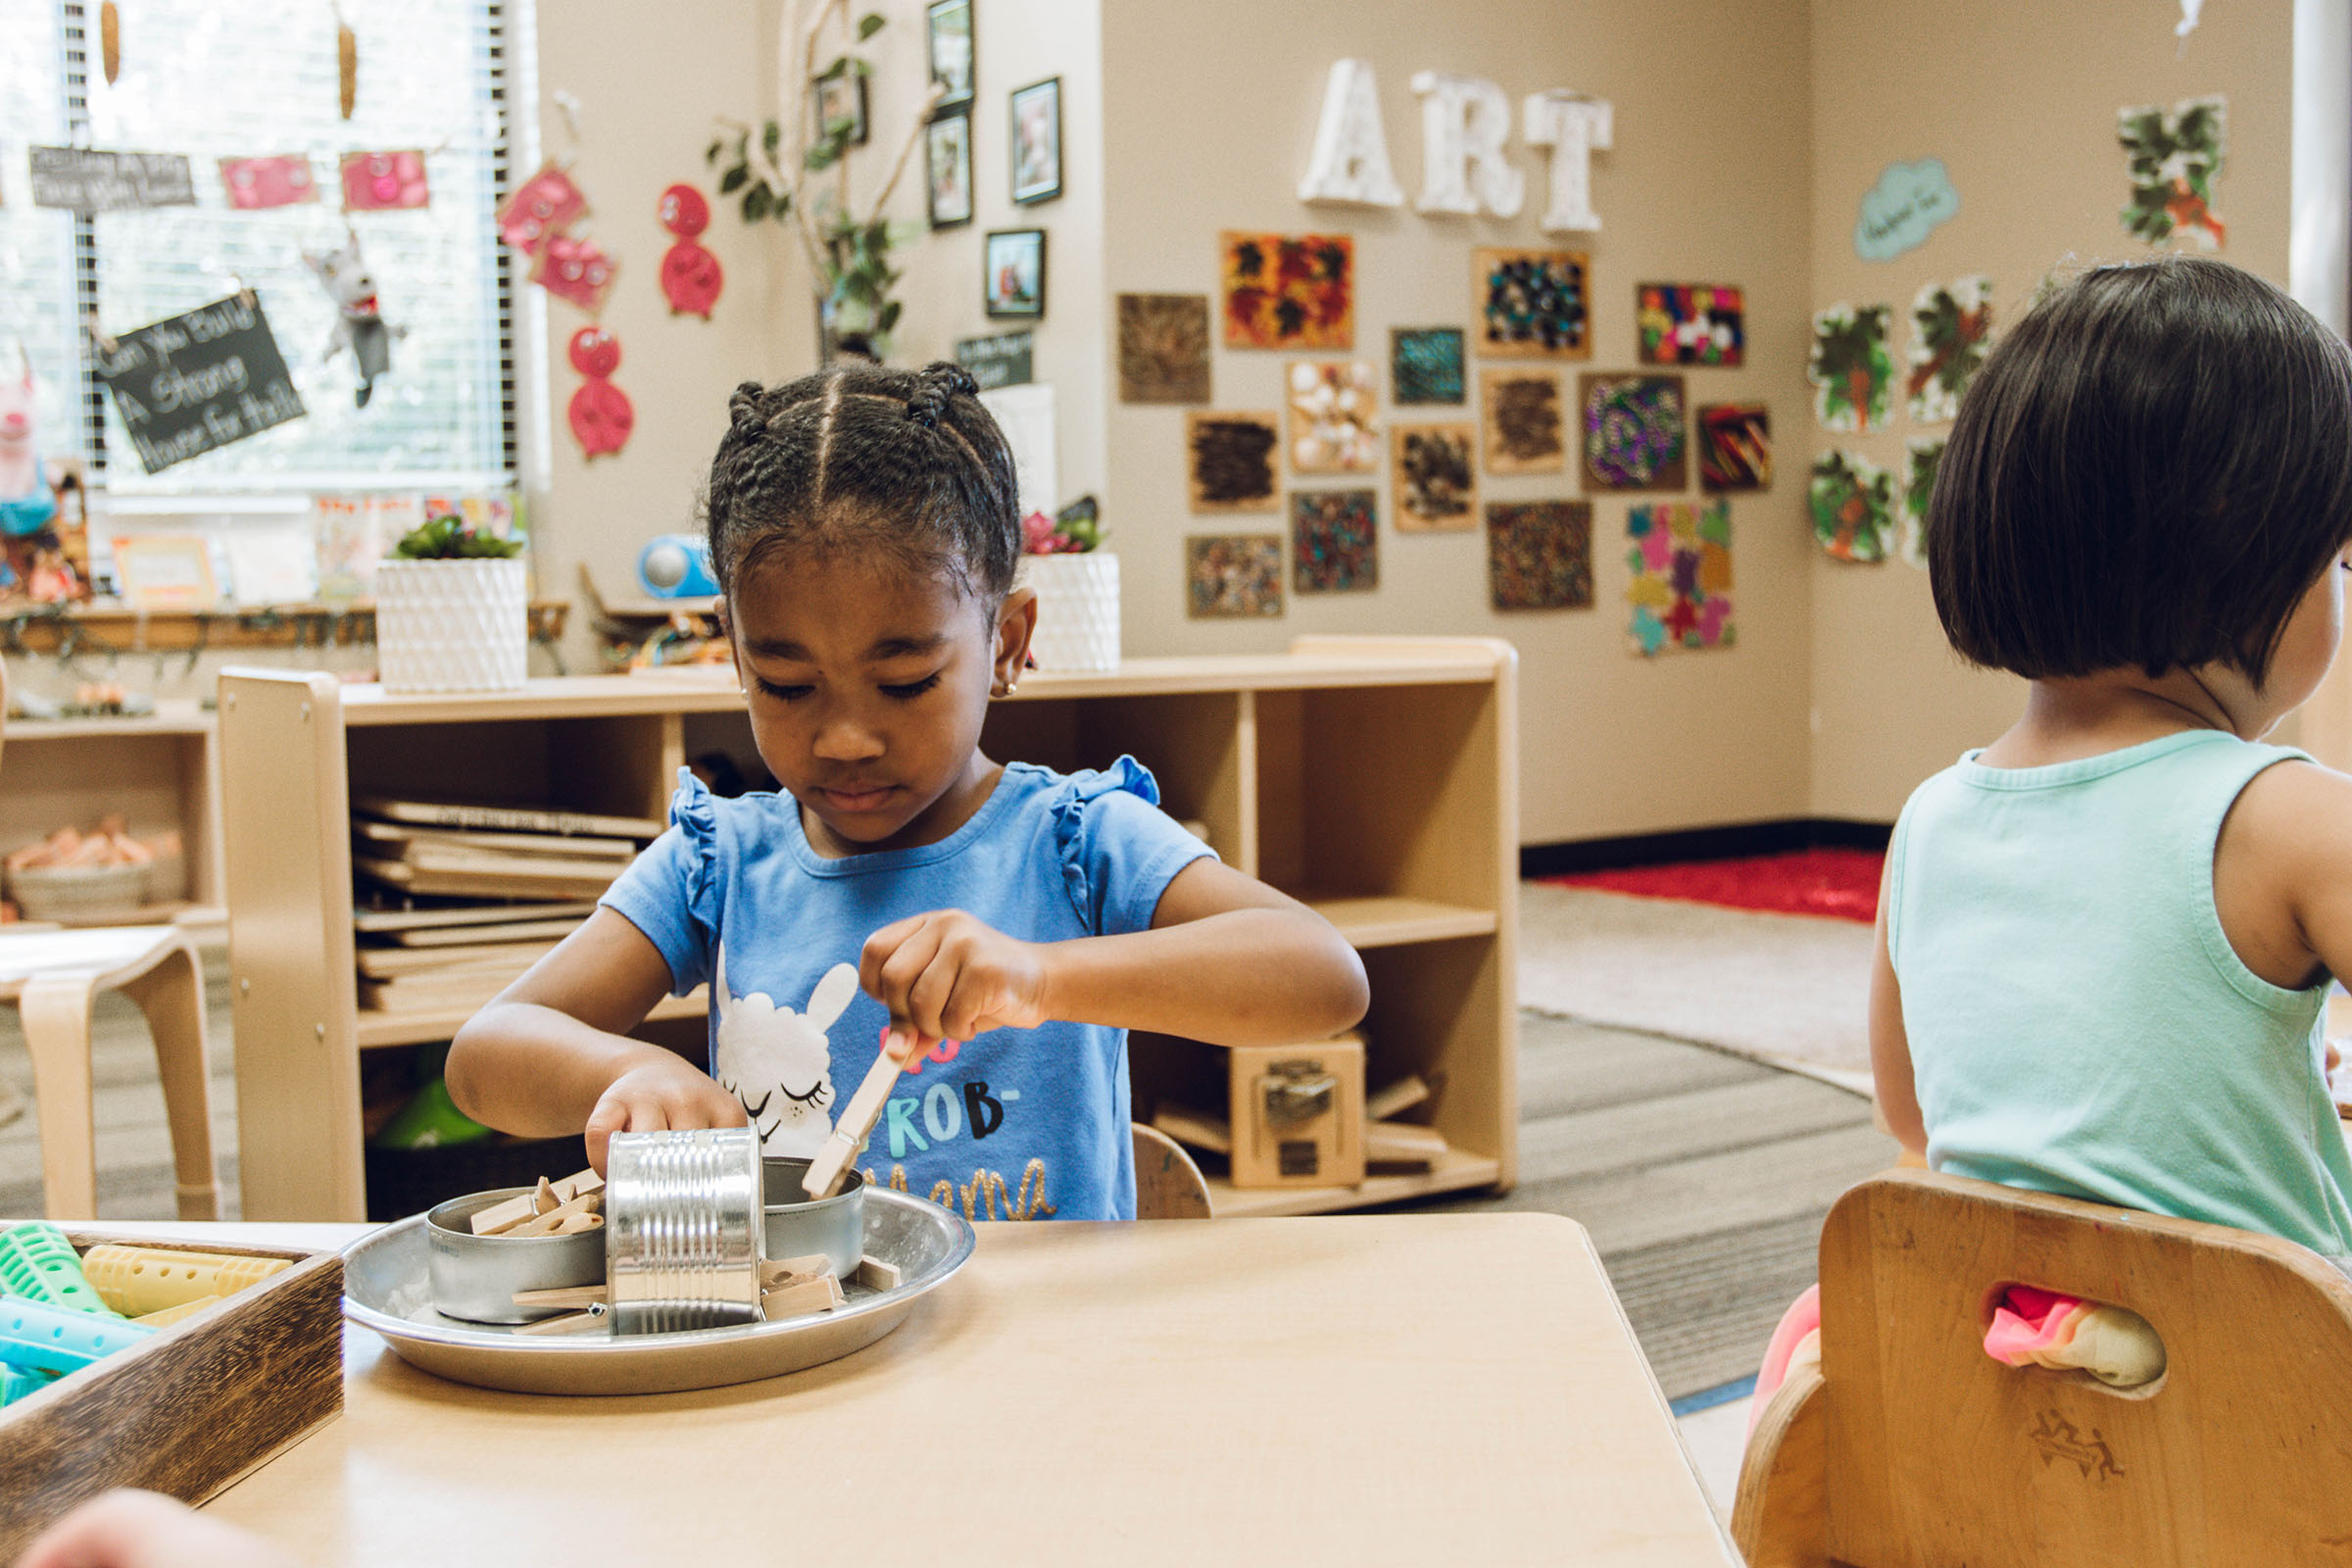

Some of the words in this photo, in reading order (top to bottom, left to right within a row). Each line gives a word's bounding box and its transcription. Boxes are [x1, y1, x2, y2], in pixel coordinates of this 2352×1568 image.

[1297, 57, 1613, 230] ART
[116, 390, 151, 429] A
[151, 356, 249, 414] Strong
[859, 1081, 1020, 1157] ROB-
